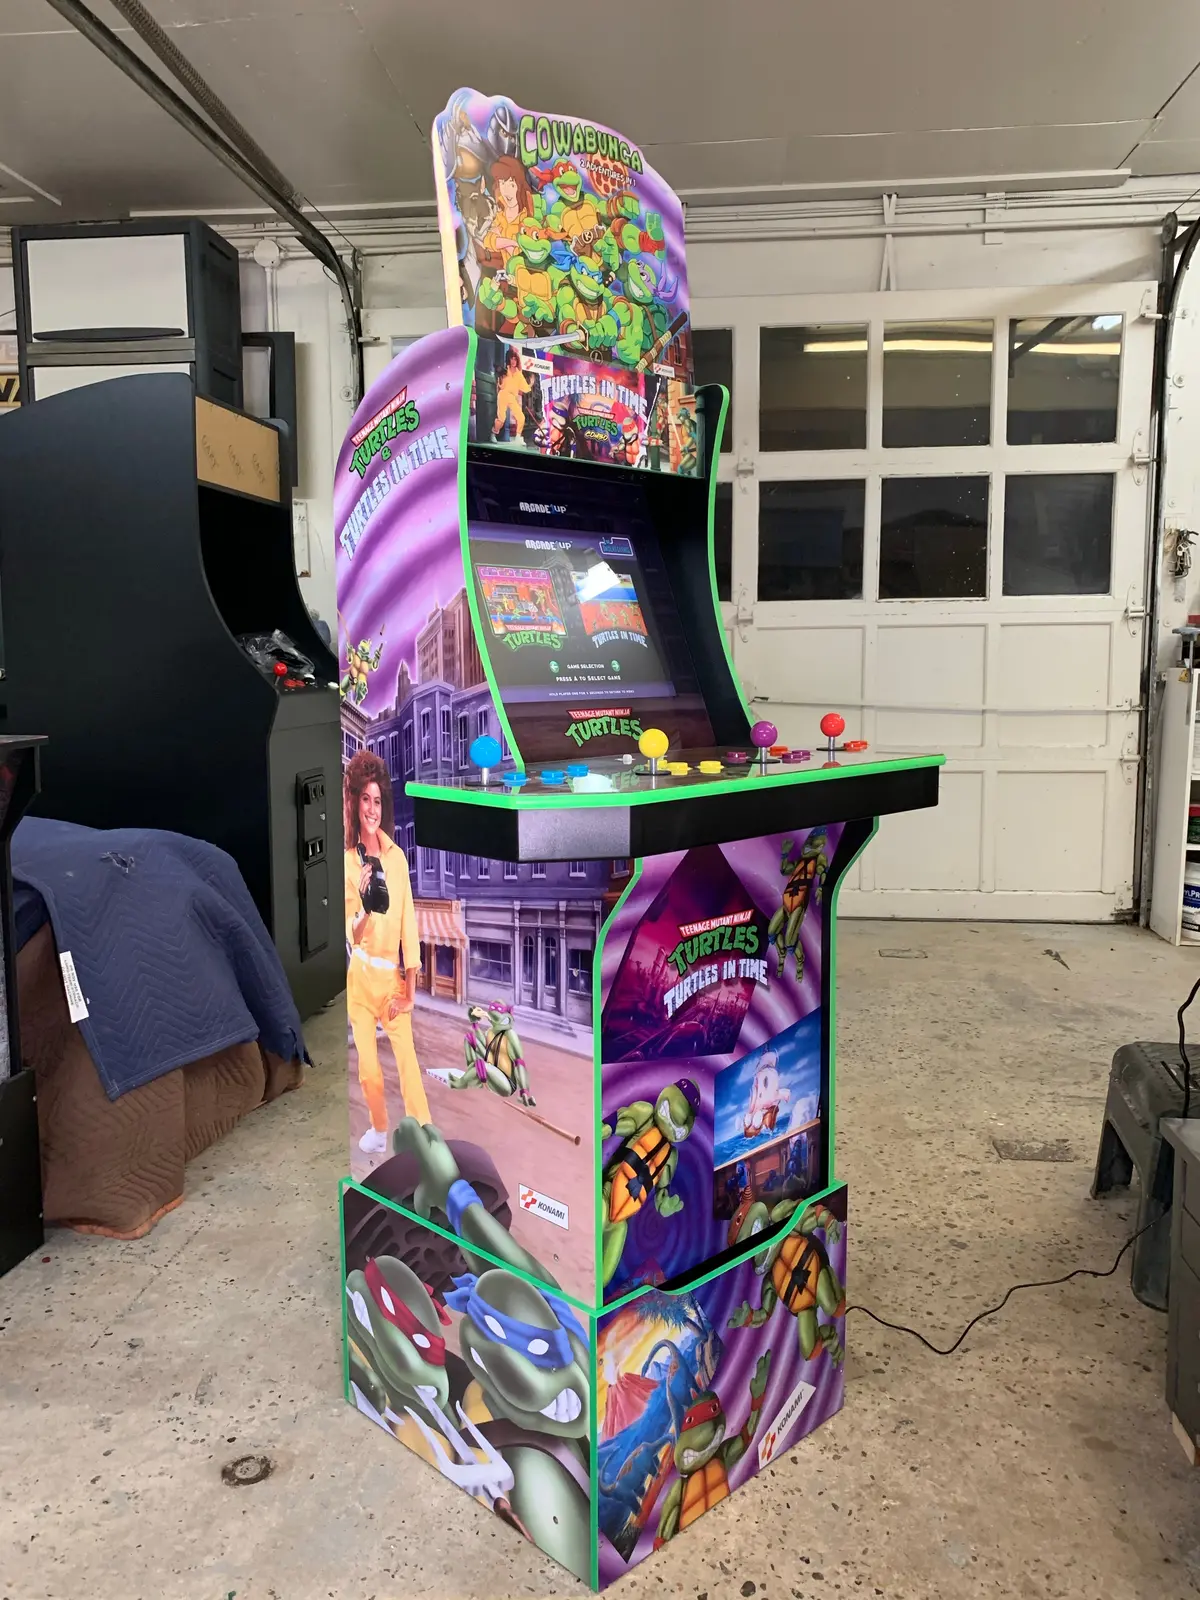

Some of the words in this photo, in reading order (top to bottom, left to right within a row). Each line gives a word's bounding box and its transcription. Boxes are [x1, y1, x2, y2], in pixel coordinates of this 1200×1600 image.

[519, 114, 644, 175] COWABUNGA
[580, 158, 586, 168] 2
[586, 160, 625, 182] ADVENTURES
[540, 374, 596, 405] TURTLES
[600, 379, 615, 399] IN
[616, 384, 649, 423] TIME
[349, 400, 420, 479] TURTLES
[572, 415, 618, 437] TURTLES
[339, 469, 391, 561] TURTLES
[389, 450, 411, 485] IN
[407, 425, 456, 470] TIME
[503, 630, 562, 650] TURTLES
[592, 630, 619, 648] TURTLES
[619, 630, 628, 640] IN
[628, 631, 648, 648] TIME
[568, 710, 596, 719] TEENAGE
[595, 708, 615, 717] MUTANT
[614, 707, 631, 716] NINJA
[564, 716, 644, 748] TURTLES
[680, 922, 710, 936] TEENAGE
[710, 914, 734, 930] MUTANT
[733, 910, 752, 924] NINJA
[667, 925, 760, 976] TURTLES
[663, 963, 719, 1019] TURTLES
[722, 959, 737, 980] IN
[739, 958, 768, 986] TIME
[537, 1201, 566, 1220] KONAMI
[777, 1390, 803, 1435] KONAMI
